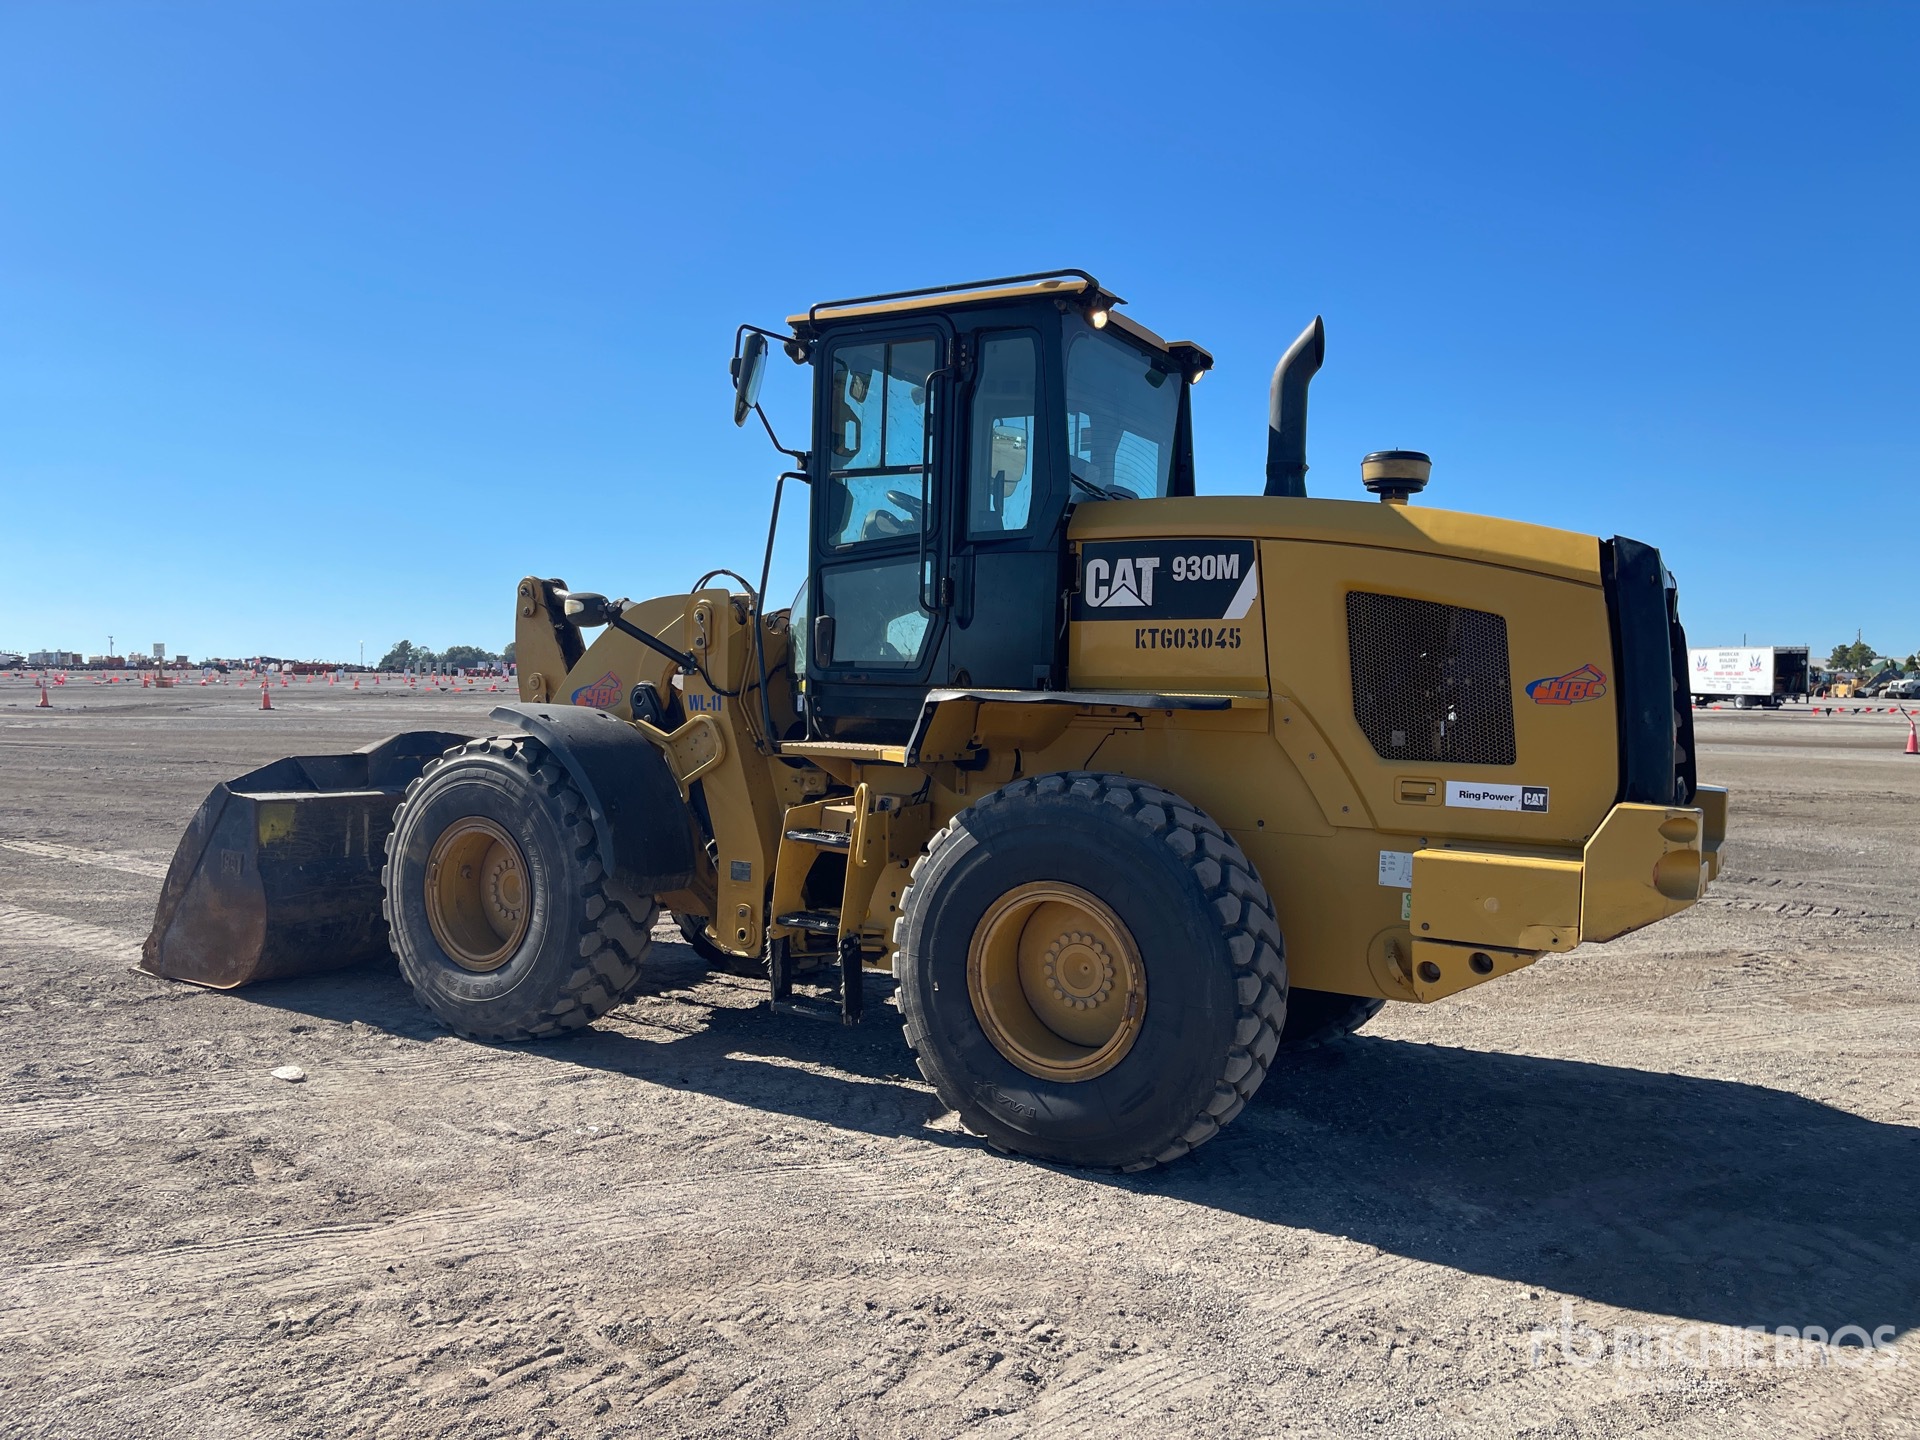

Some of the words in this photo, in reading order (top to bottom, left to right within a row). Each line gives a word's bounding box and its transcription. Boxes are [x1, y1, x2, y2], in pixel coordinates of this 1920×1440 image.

[1085, 557, 1160, 608] CAT
[1172, 554, 1240, 582] 930M
[1135, 627, 1242, 650] KTG03045
[1548, 681, 1602, 700] HBC
[688, 694, 722, 711] WL-11
[1459, 790, 1482, 801] Ring
[1482, 791, 1515, 802] Power
[1523, 792, 1545, 806] CAT
